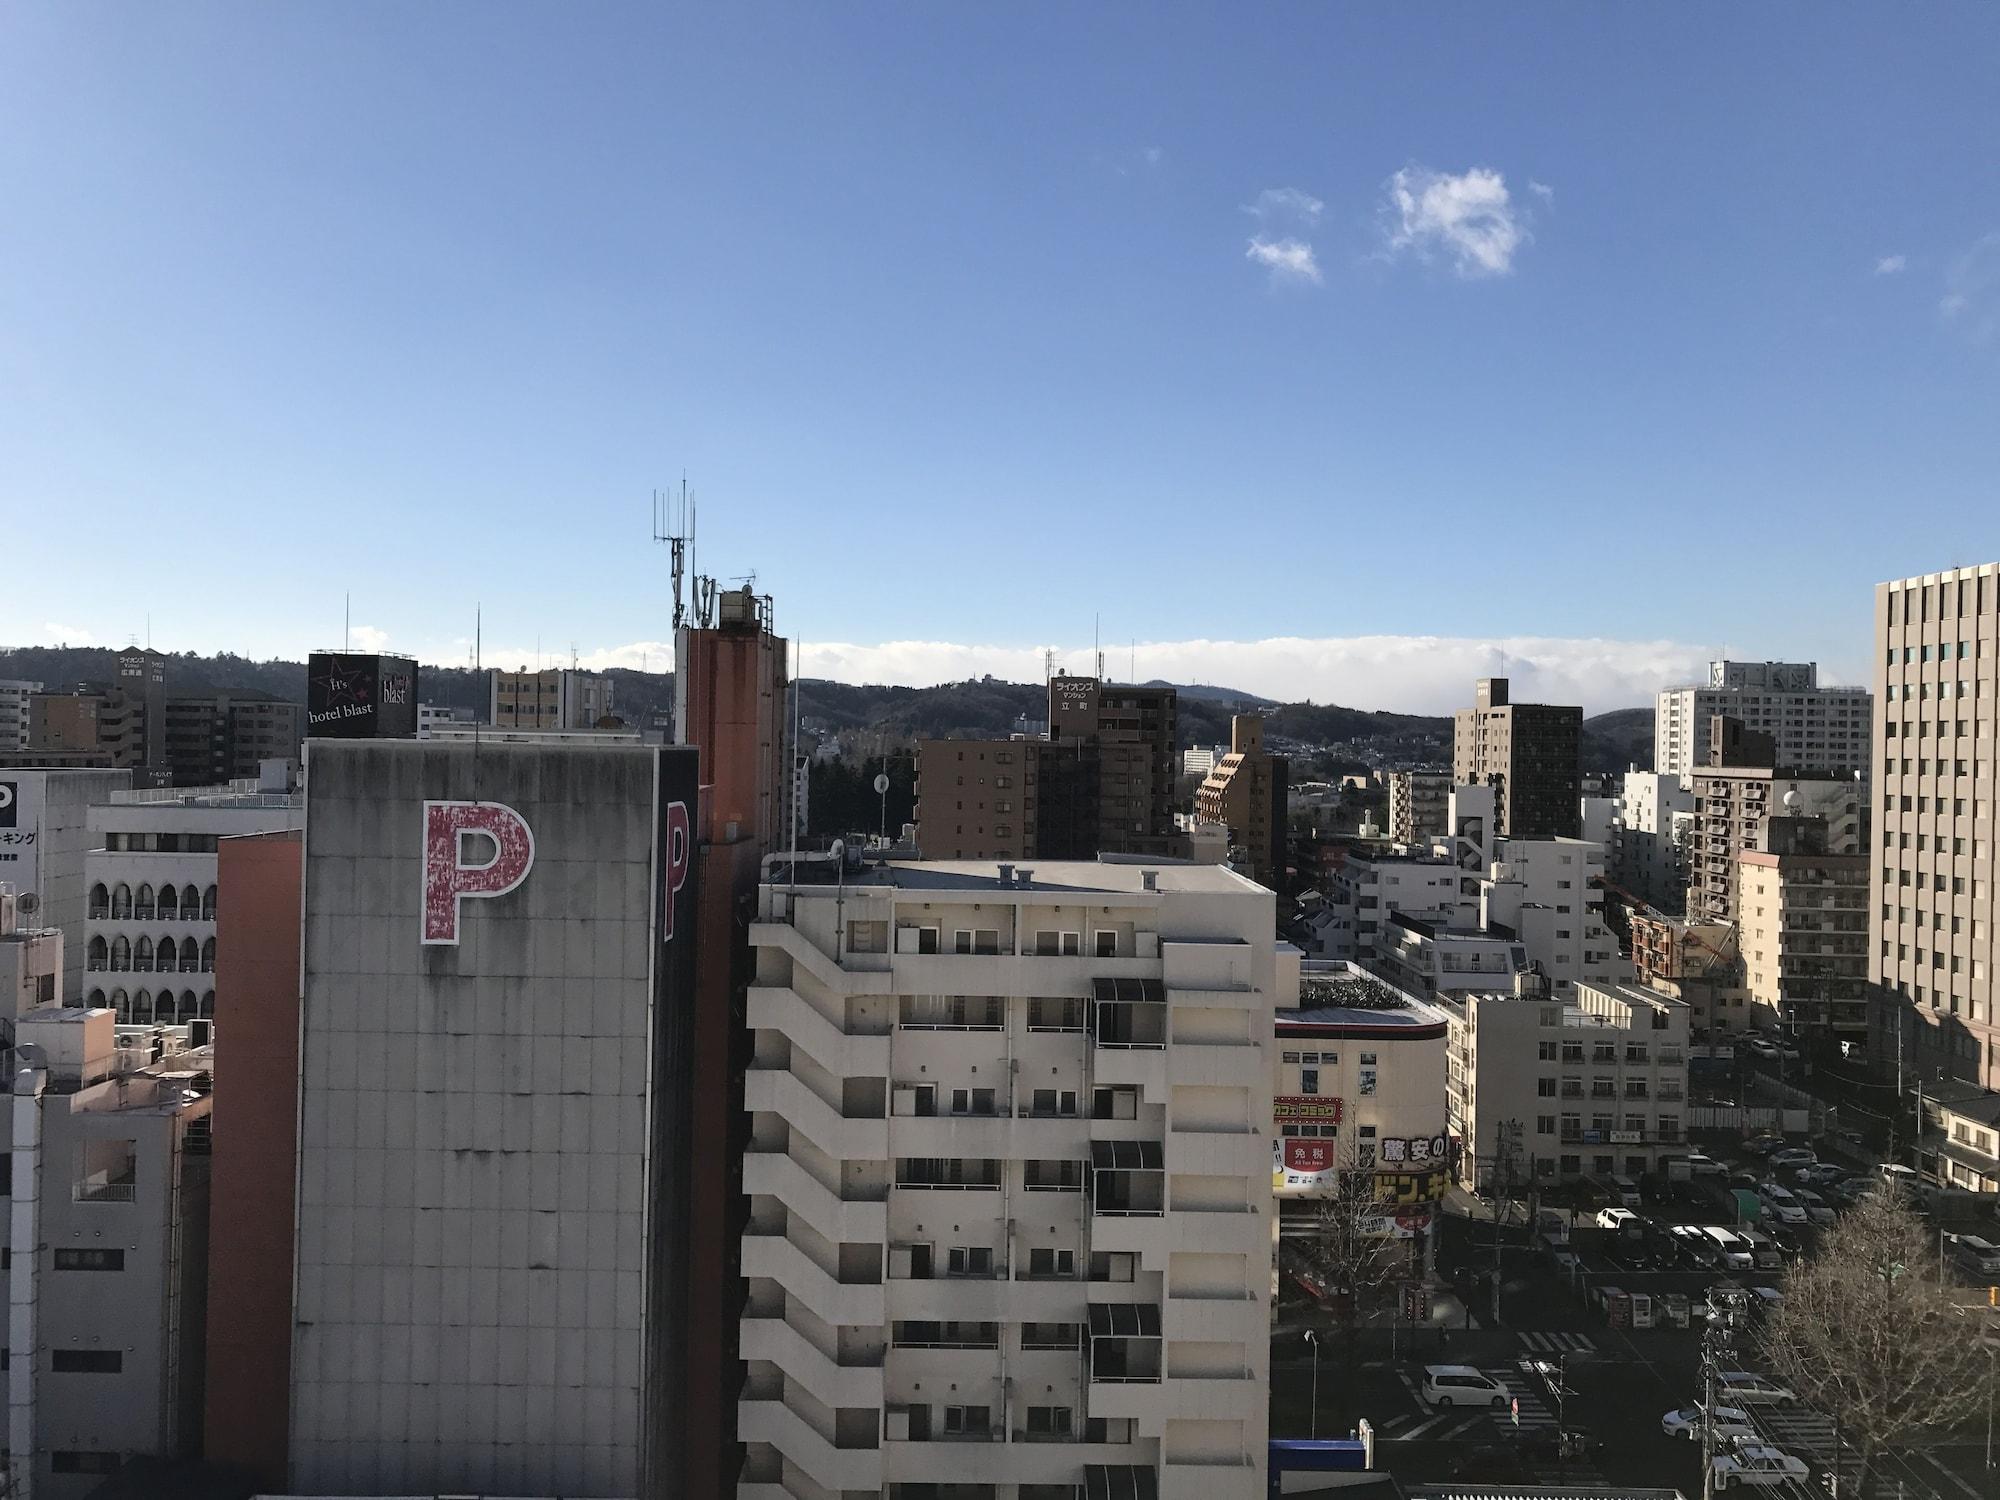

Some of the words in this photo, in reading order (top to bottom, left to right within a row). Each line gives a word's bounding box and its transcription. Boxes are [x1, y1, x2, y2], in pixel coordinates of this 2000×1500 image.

[383, 679, 406, 704] blast
[308, 706, 341, 724] hotel
[343, 702, 373, 718] blast
[0, 832, 36, 845] キング
[420, 800, 535, 945] P
[664, 800, 689, 942] P
[1295, 1147, 1324, 1160] 免税
[1382, 1137, 1445, 1162] 驚安の
